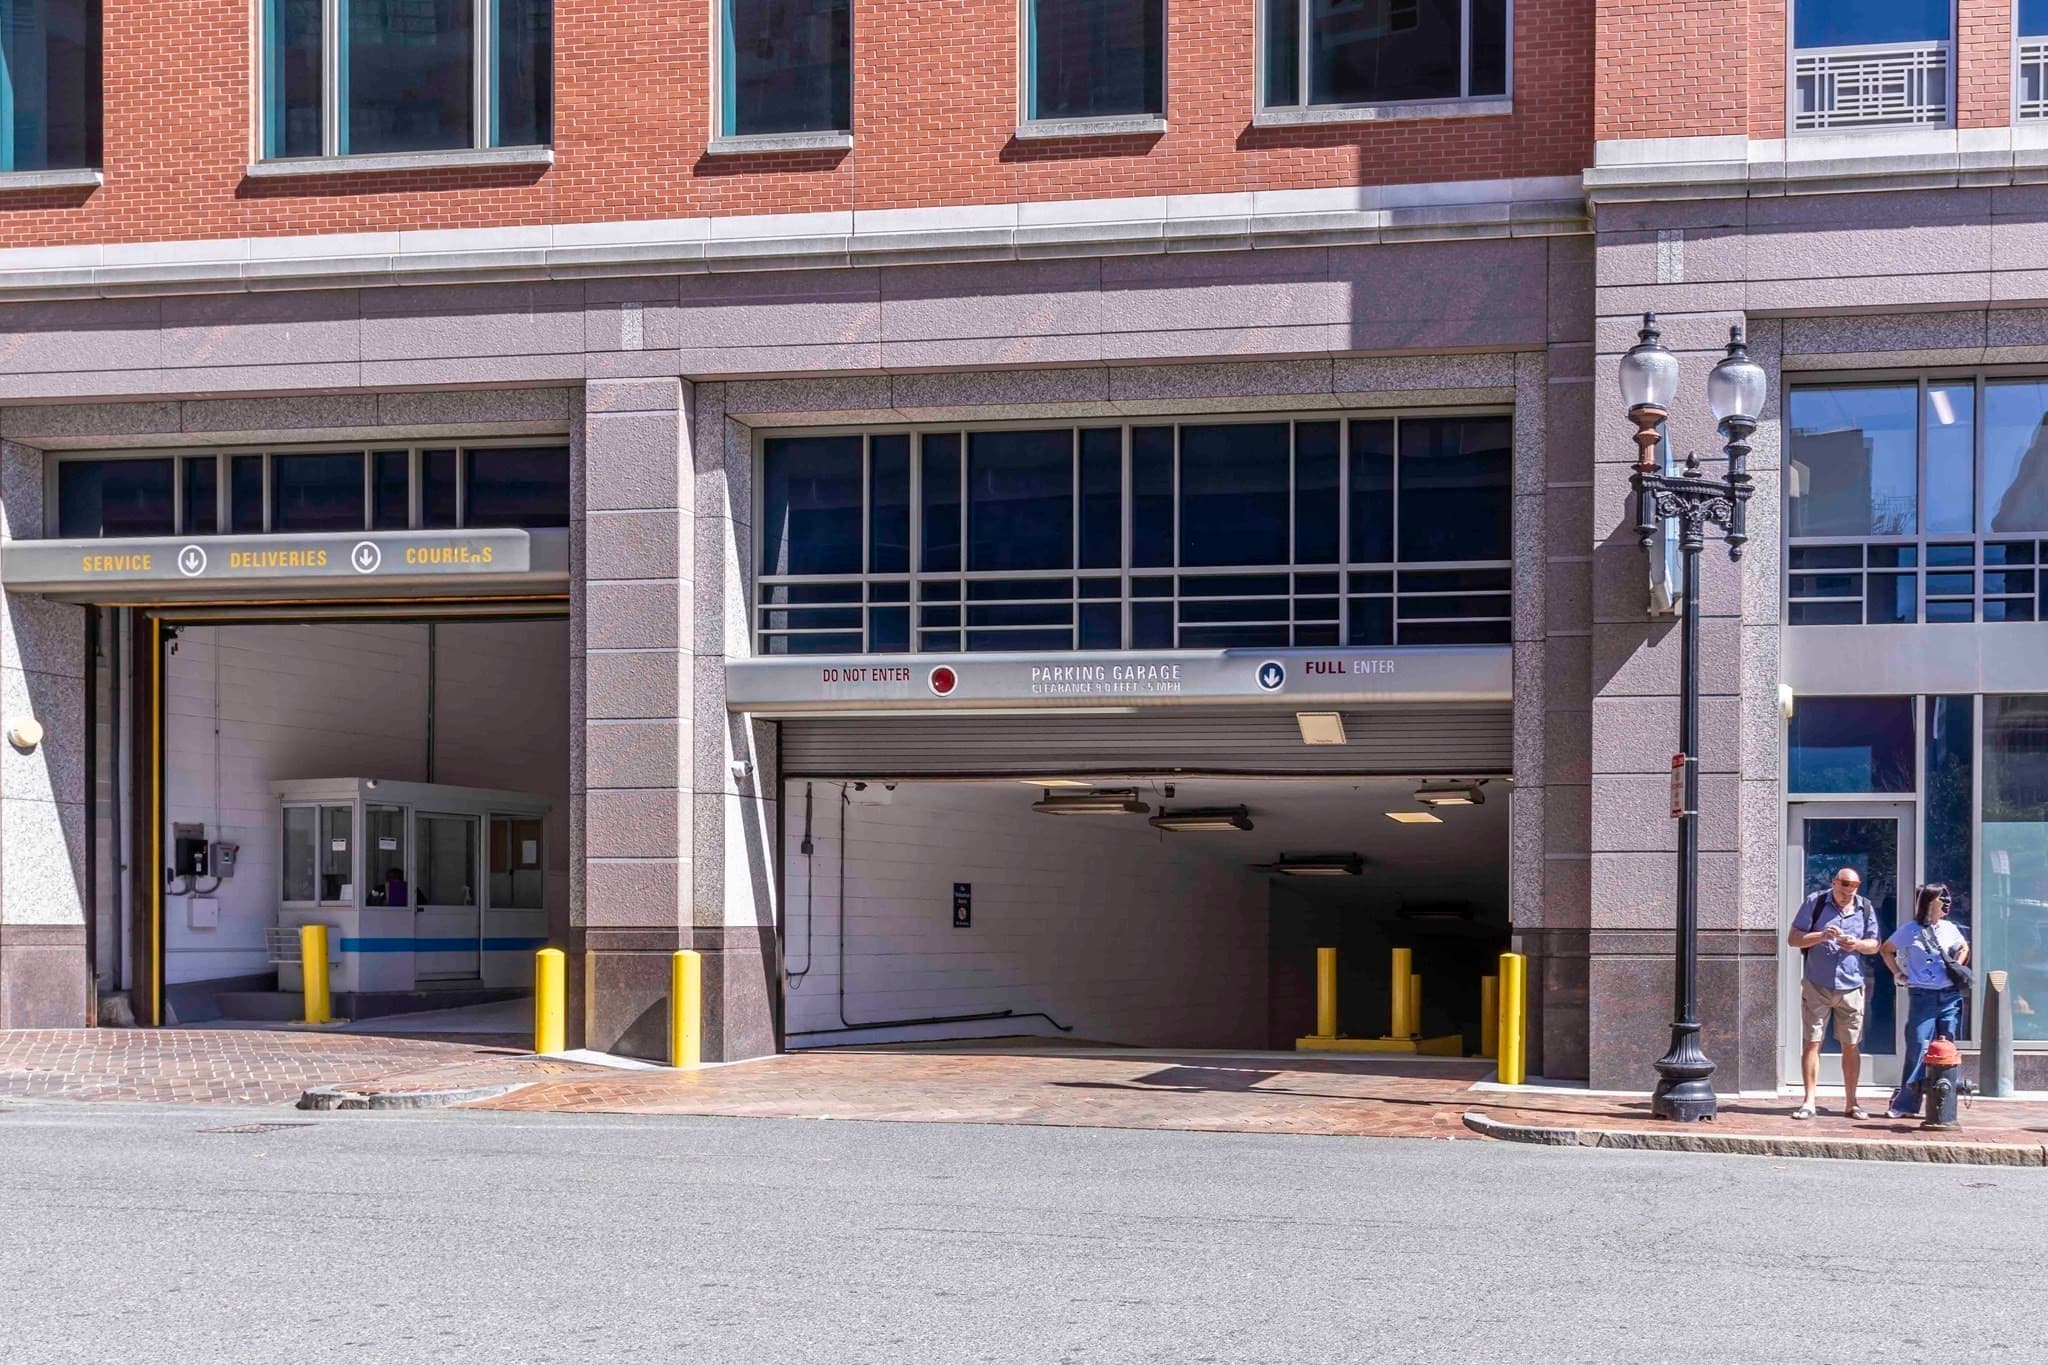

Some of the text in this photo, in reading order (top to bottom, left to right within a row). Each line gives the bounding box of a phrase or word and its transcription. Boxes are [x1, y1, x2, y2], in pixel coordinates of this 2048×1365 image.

[82, 554, 152, 573] SERVICE
[229, 550, 328, 569] DELIVERIES
[823, 667, 910, 682] DO NOT ENTER
[1031, 664, 1182, 681] PARKING GARAGE
[1304, 660, 1395, 675] FULL ENTER
[1031, 682, 1093, 694] CLEARANCE
[1156, 681, 1182, 692] MPH
